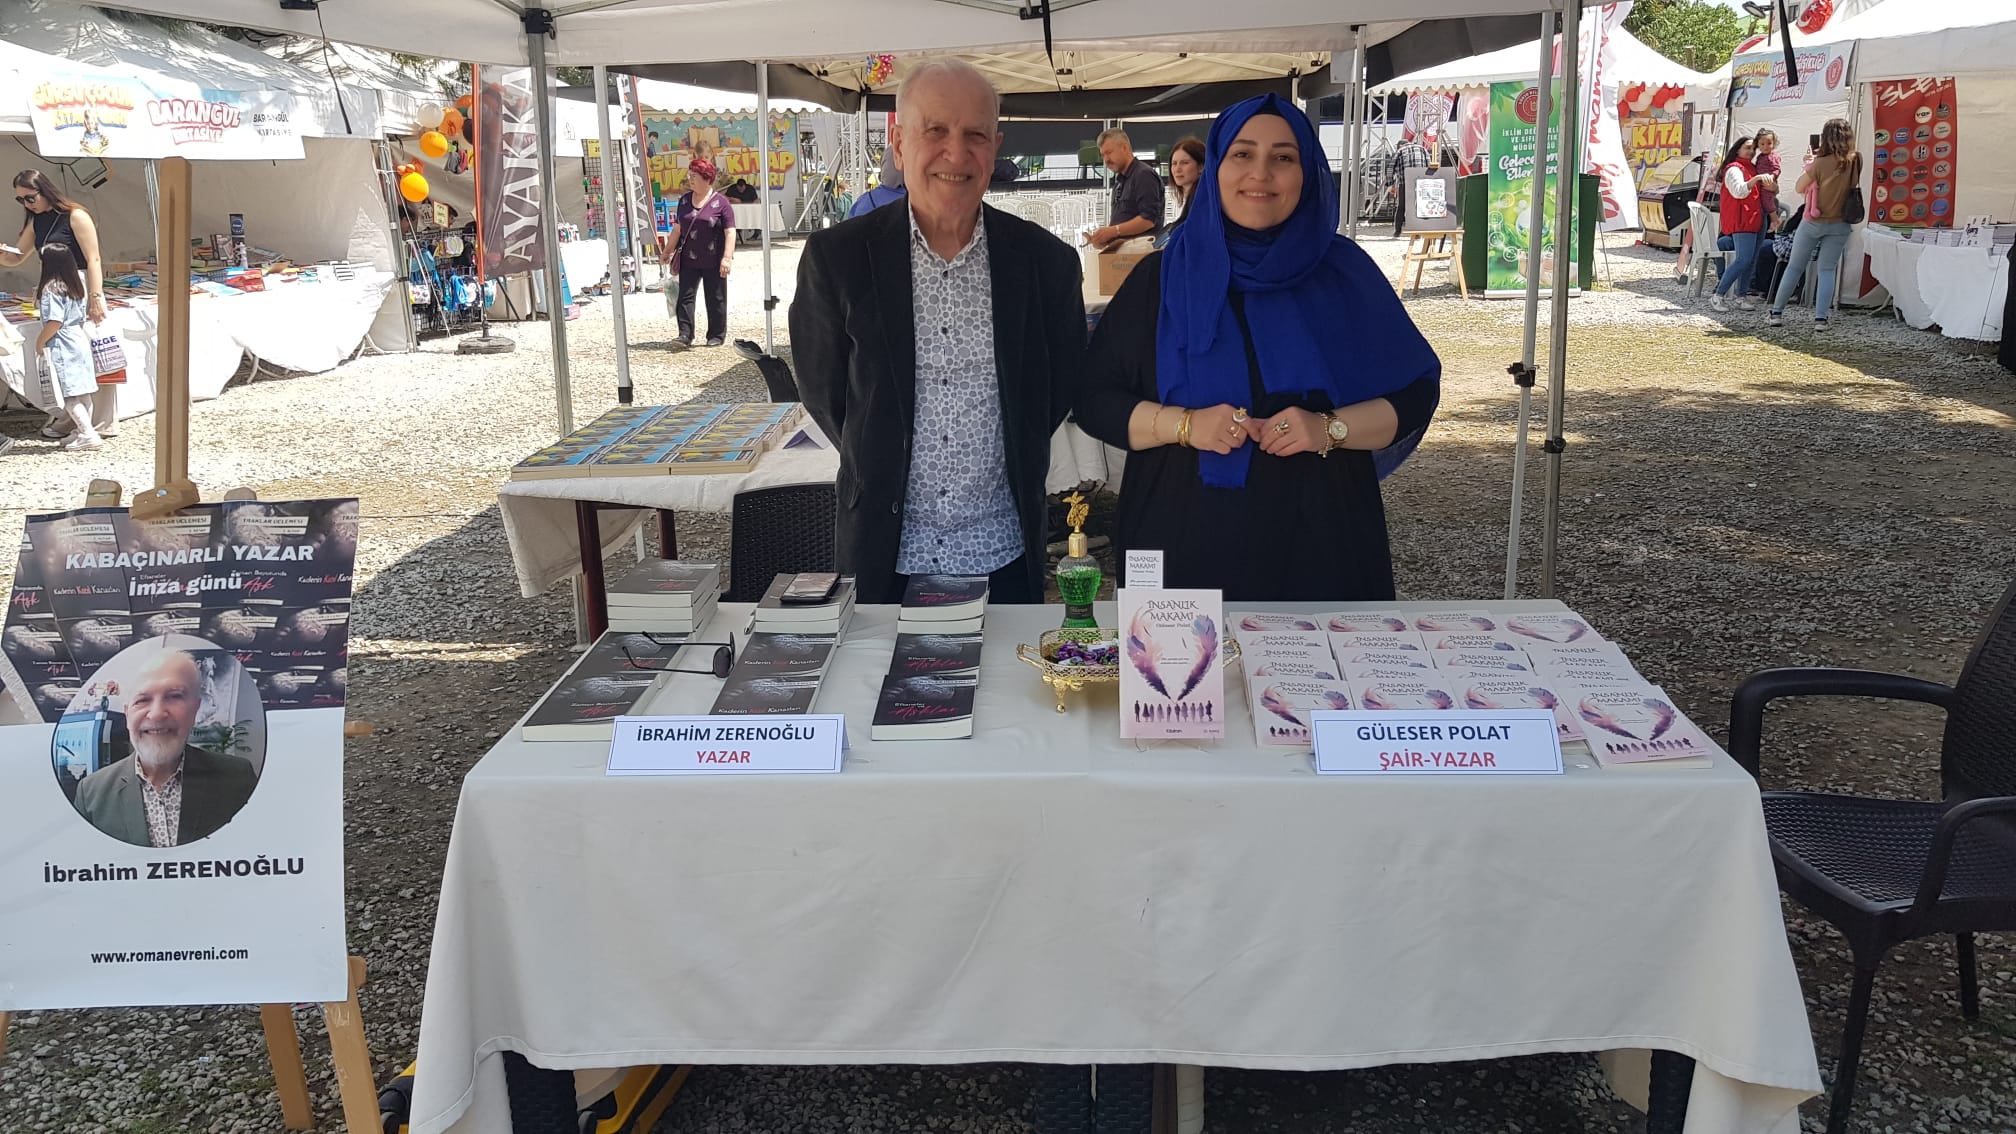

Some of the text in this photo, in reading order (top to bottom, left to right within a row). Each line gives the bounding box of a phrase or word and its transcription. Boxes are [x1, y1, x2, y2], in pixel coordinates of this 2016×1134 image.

[147, 99, 240, 128] BARANGÜL
[1632, 119, 1682, 149] KİTA
[66, 545, 314, 571] KABAÇINARLI YAZAR
[129, 572, 242, 596] İmza günü
[637, 723, 815, 742] İBRAHİM ZERENOĞLU
[1356, 723, 1511, 741] GÜLESER POLAT
[696, 751, 751, 764] YAZAR
[1379, 748, 1496, 771] ŞAİR-YAZAR
[44, 855, 305, 882] İbrahim ZERENOĞLU
[91, 947, 248, 963] www.romanevreni.com
